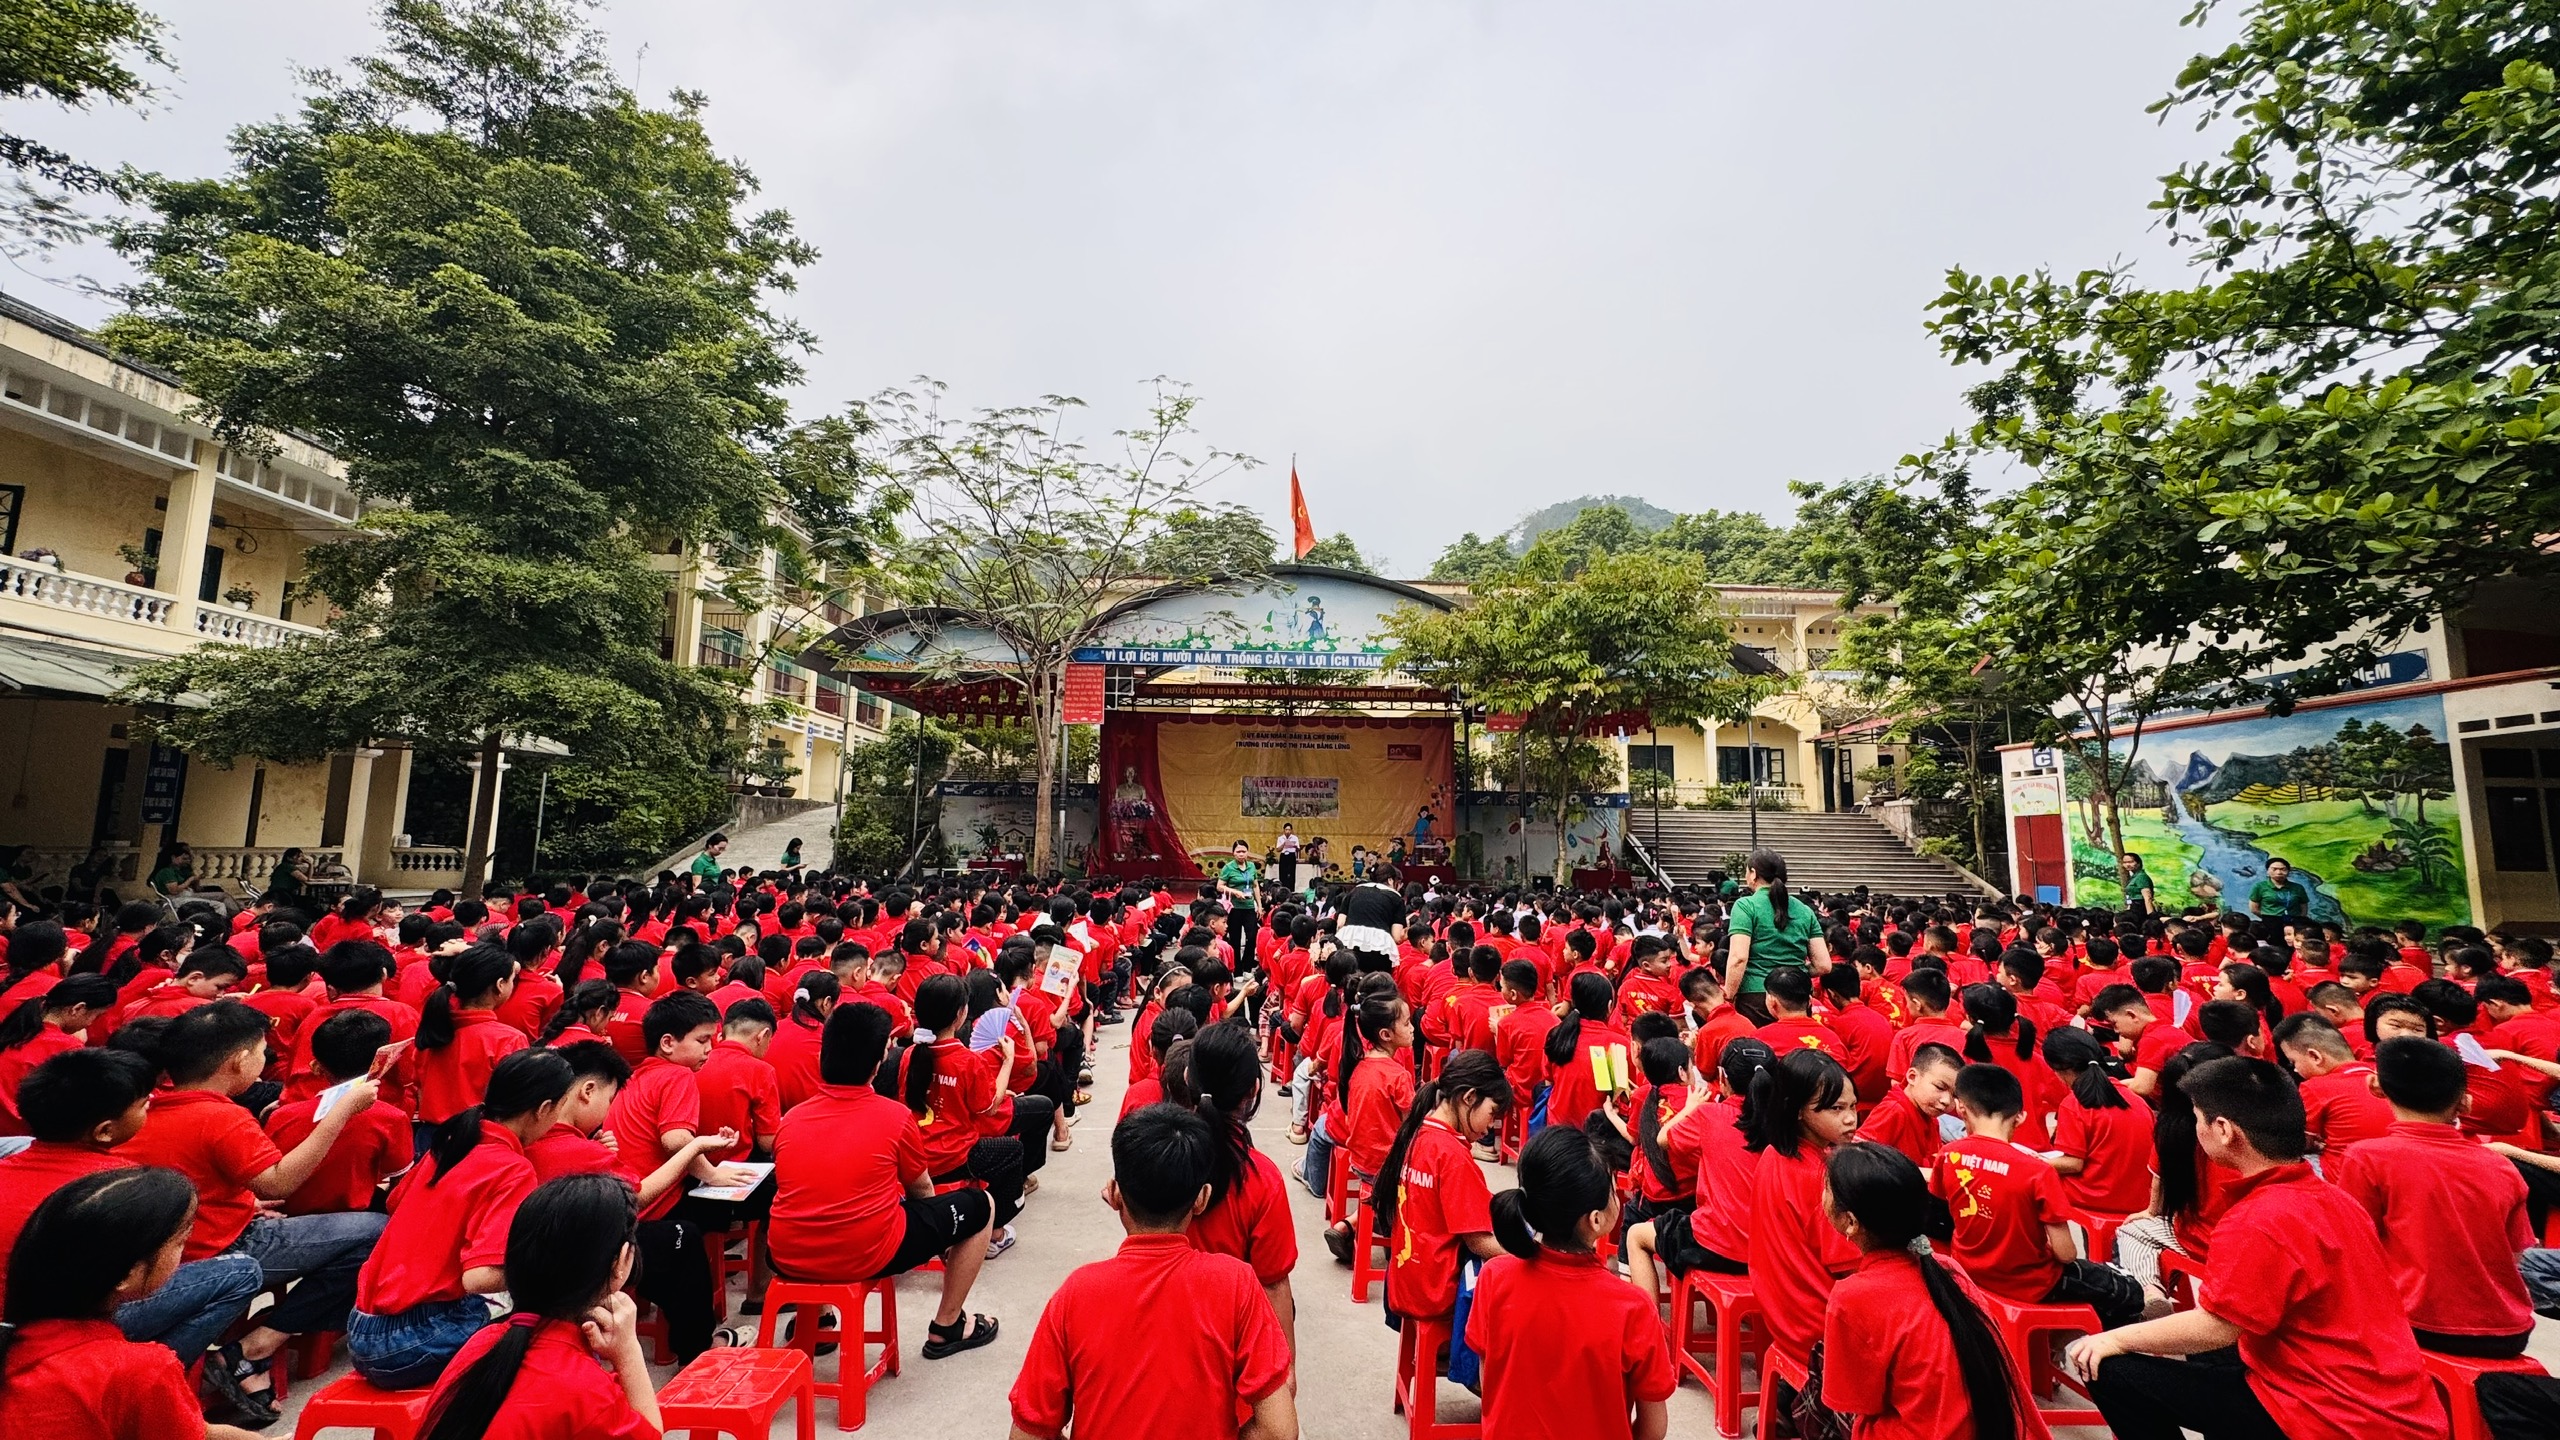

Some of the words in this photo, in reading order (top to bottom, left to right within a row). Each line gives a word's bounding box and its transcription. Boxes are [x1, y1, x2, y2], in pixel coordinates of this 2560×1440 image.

[1119, 651, 1136, 664] LỢI
[1140, 649, 1159, 662] ÍCH
[1162, 650, 1192, 663] MƯỜI
[1195, 651, 1221, 664] NĂM
[1225, 650, 1262, 665] TRỒNG
[1265, 653, 1287, 666] CÂY
[1295, 654, 1306, 666] VÌ
[1309, 654, 1327, 668] LỢI
[1331, 653, 1349, 667] ÍCH
[1343, 690, 1365, 698] NAM
[1961, 1153, 1983, 1170] VIỆT
[1983, 1158, 2010, 1176] NAM
